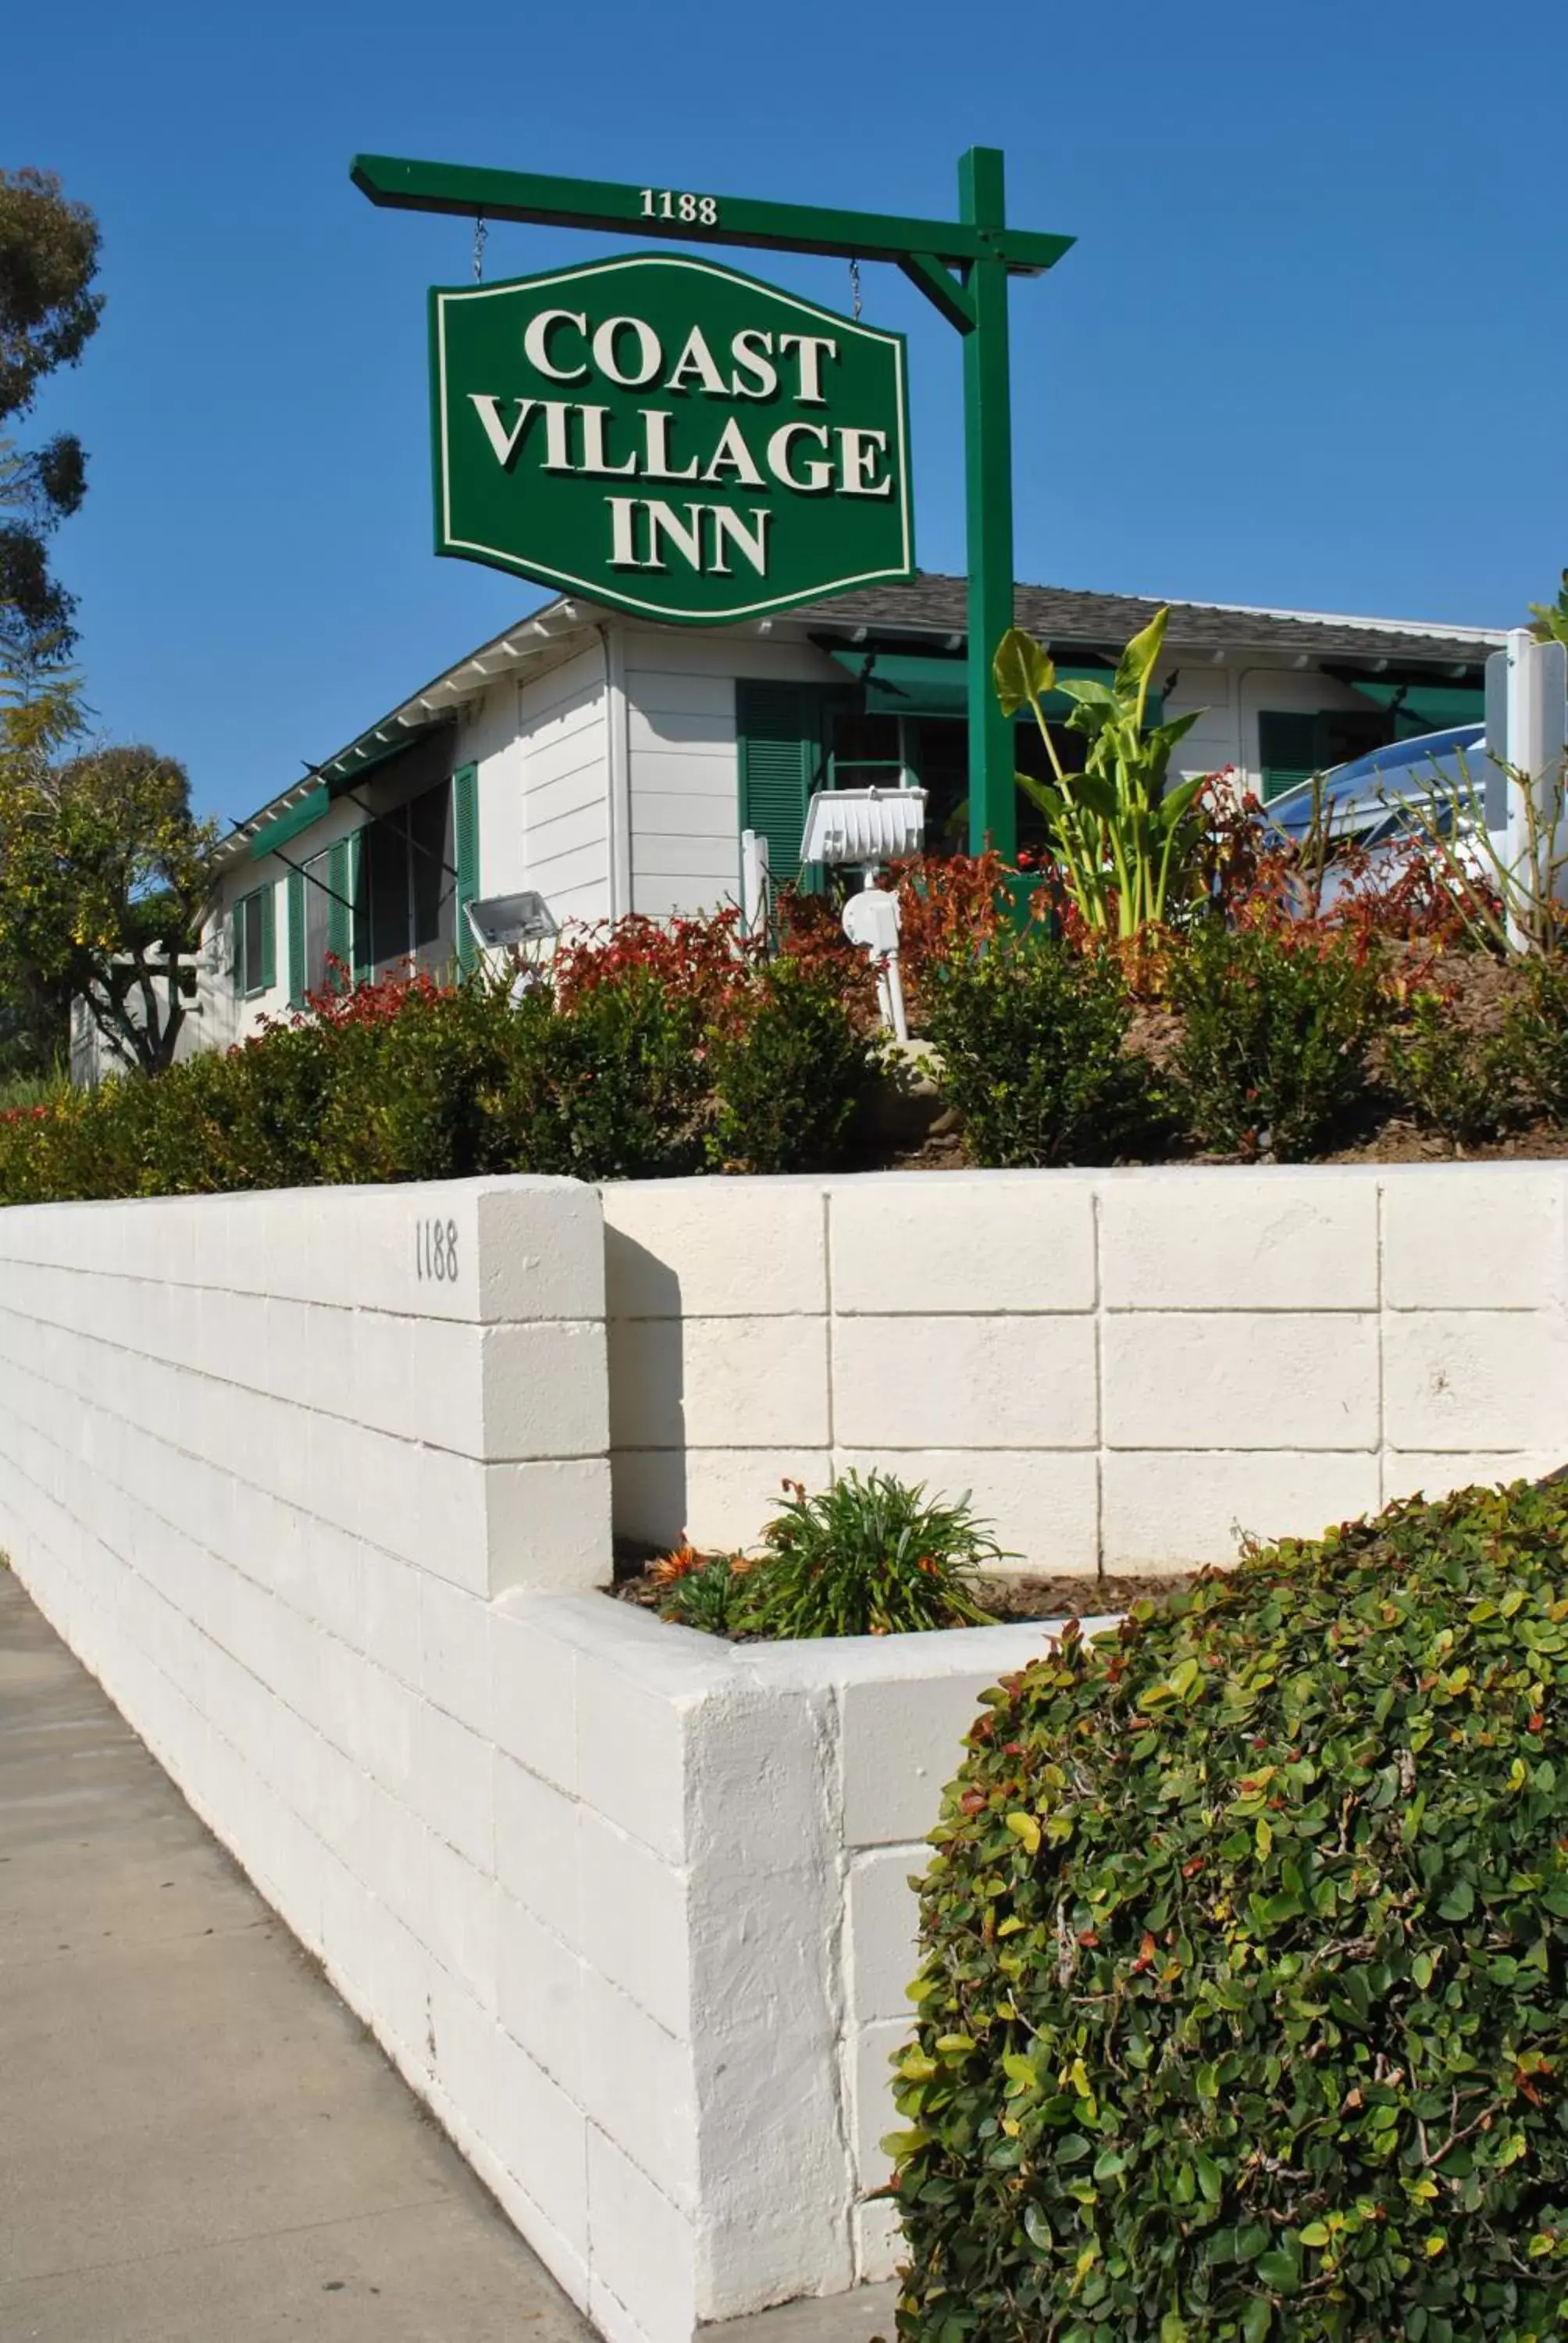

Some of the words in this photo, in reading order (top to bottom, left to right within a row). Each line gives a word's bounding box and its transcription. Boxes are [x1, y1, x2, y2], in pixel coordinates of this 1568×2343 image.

[640, 188, 718, 226] 1188
[524, 309, 837, 403] COAST
[466, 394, 892, 496] VILLAGE
[604, 496, 772, 577] INN
[416, 1218, 458, 1282] 1188
